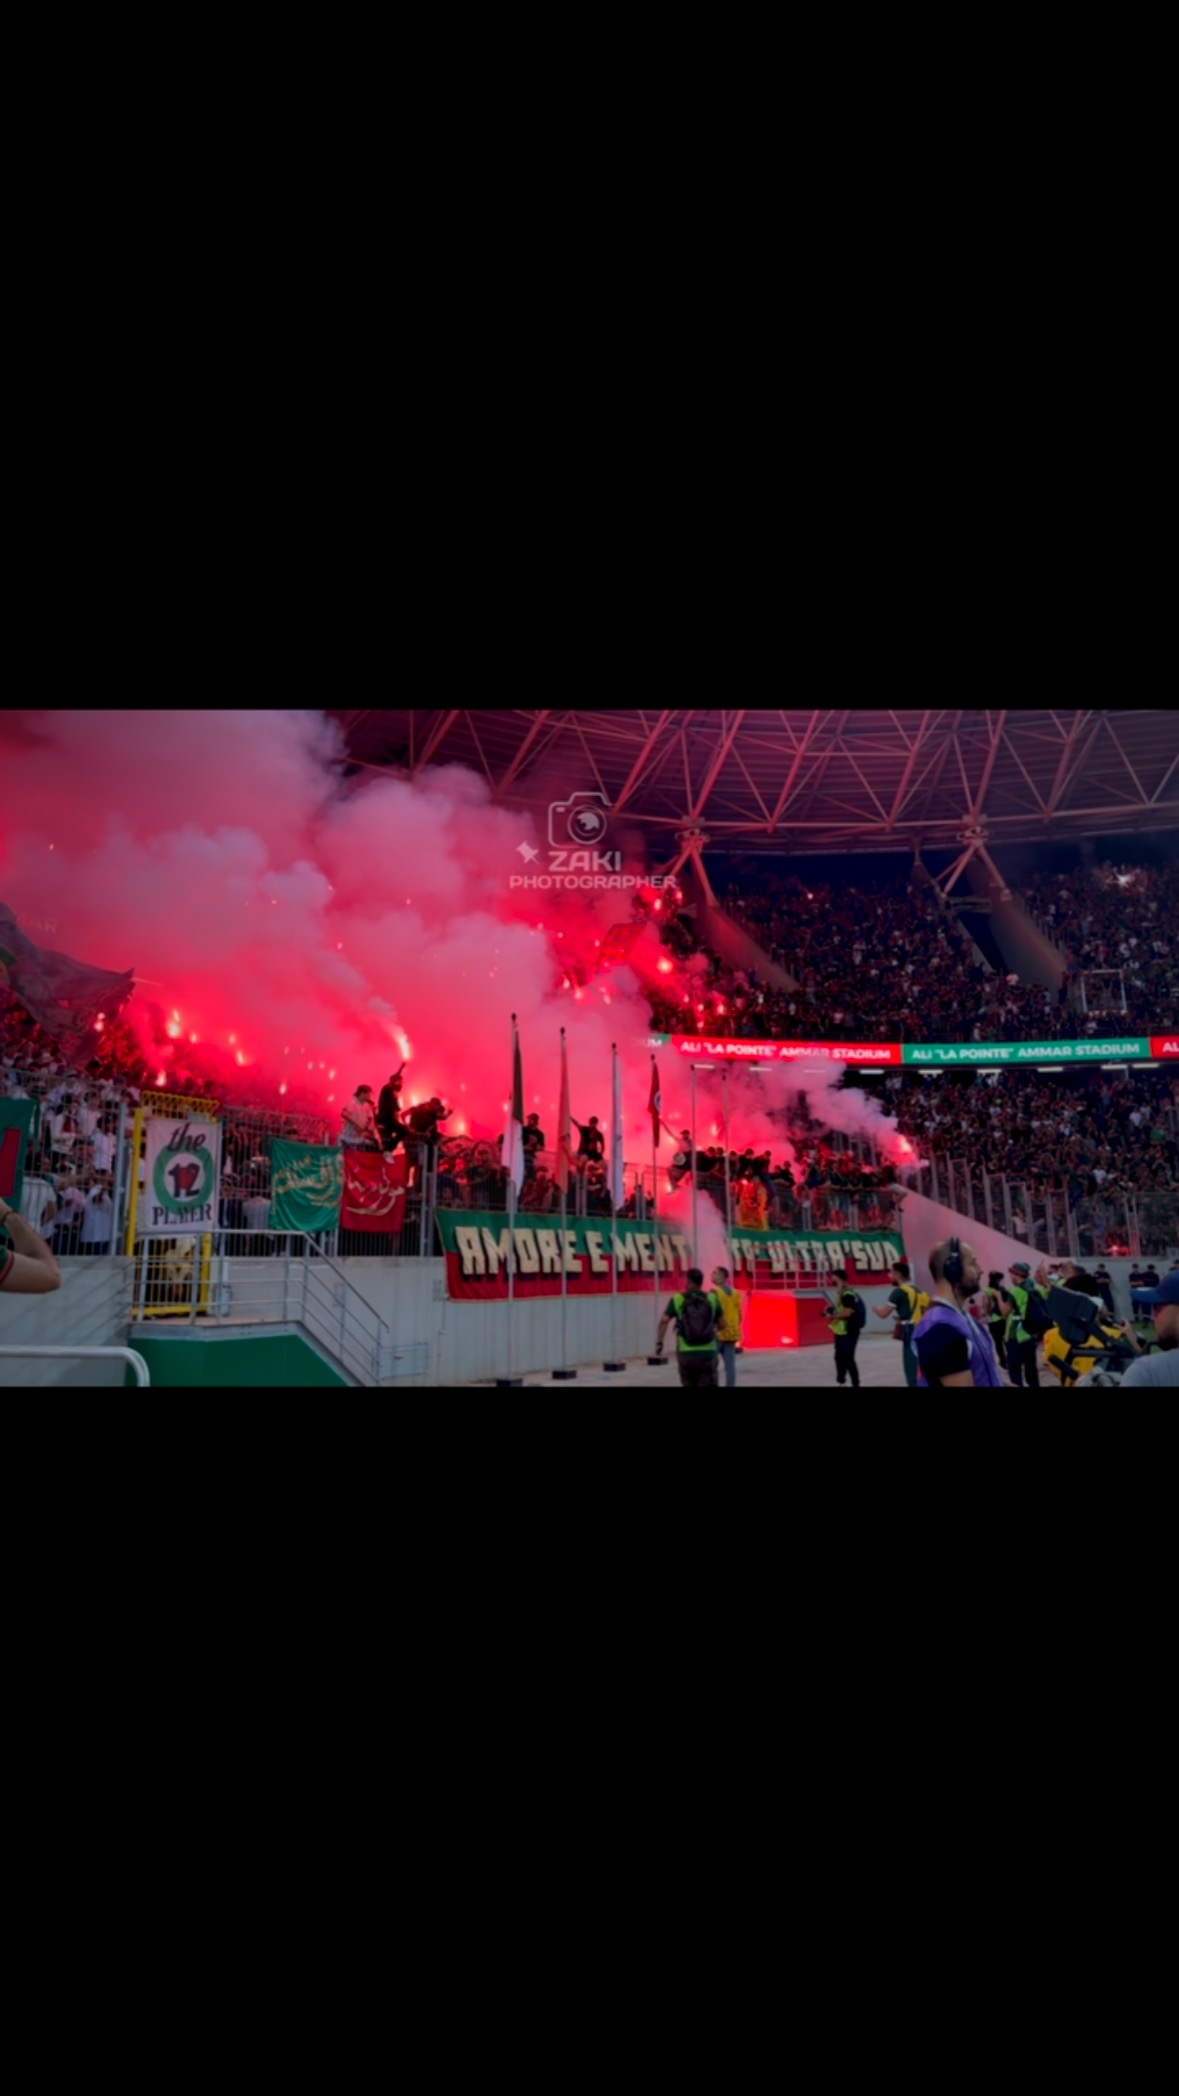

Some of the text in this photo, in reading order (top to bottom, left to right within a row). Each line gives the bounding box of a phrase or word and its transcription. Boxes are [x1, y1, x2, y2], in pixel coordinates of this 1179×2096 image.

[681, 1041, 891, 1060] ALI "LA POINTE" AMMAR STADIUM
[911, 1042, 1140, 1061] ALI "LA POINTE" AMMAR STADIUM
[1162, 1041, 1179, 1053] AL
[167, 1122, 206, 1153] the
[168, 1162, 201, 1198] 12
[152, 1203, 212, 1226] PLAYER
[455, 1226, 582, 1275] AMORE
[585, 1230, 609, 1273] E
